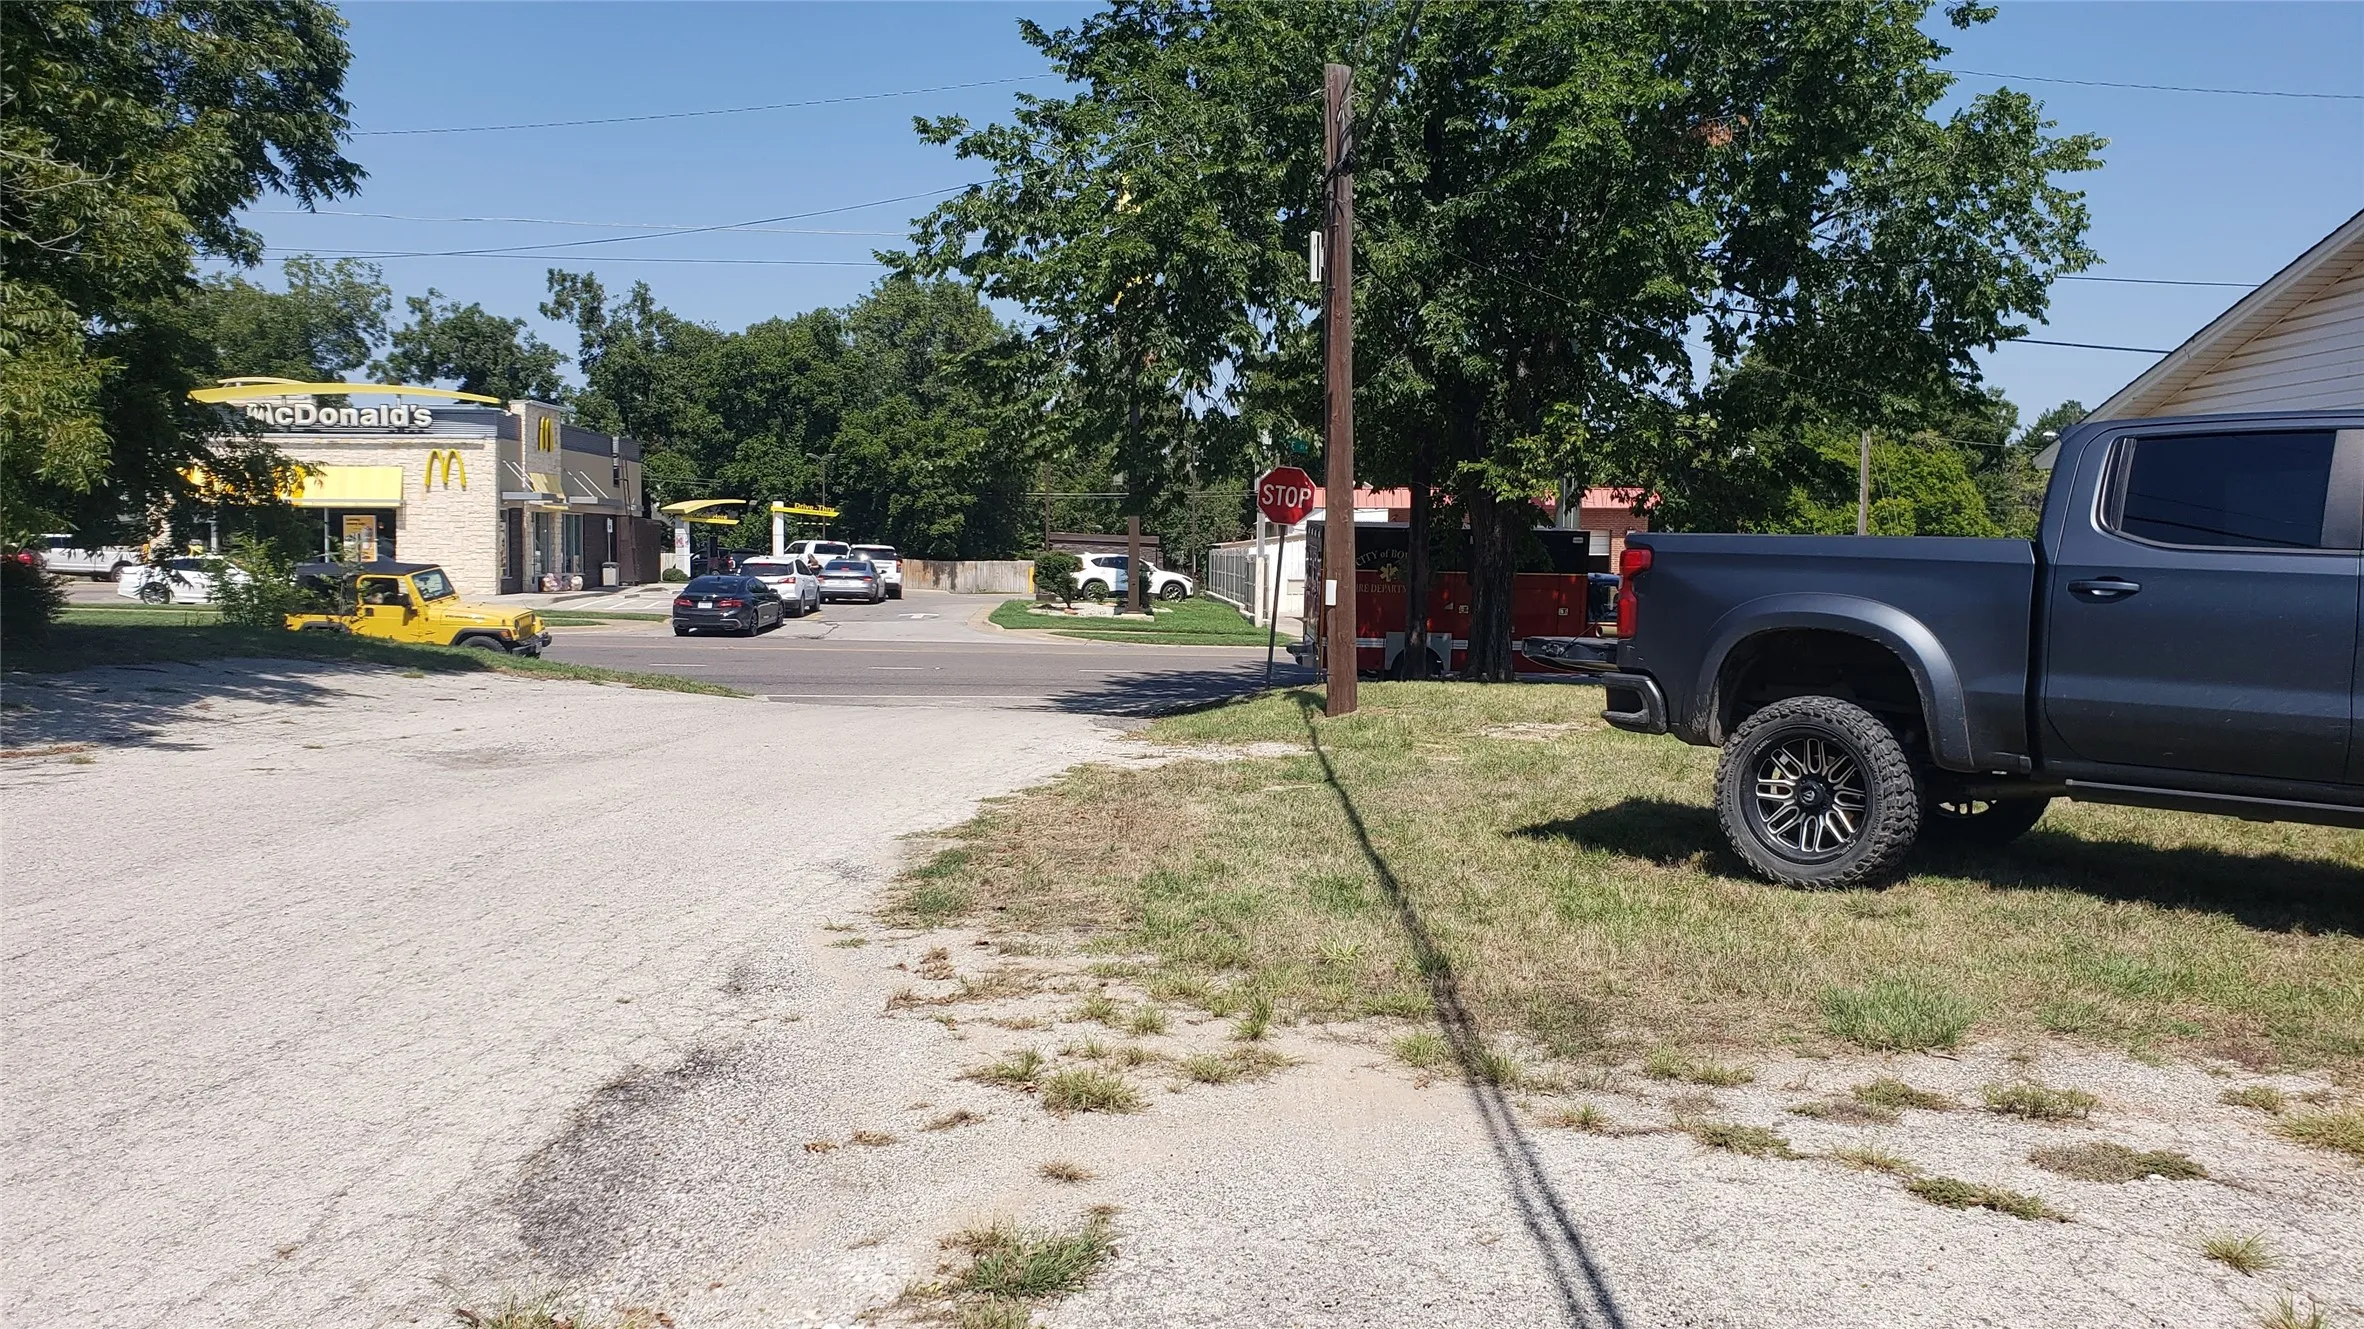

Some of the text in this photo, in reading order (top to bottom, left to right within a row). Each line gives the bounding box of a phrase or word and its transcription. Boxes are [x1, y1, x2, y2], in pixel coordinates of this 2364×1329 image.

[246, 403, 433, 428] McDonald's
[1261, 483, 1312, 509] STOP
[1355, 550, 1378, 567] CITY
[1380, 548, 1391, 558] of
[1355, 583, 1370, 593] IRE
[1753, 739, 1772, 756] FUEL
[1837, 839, 1857, 855] FUEL
